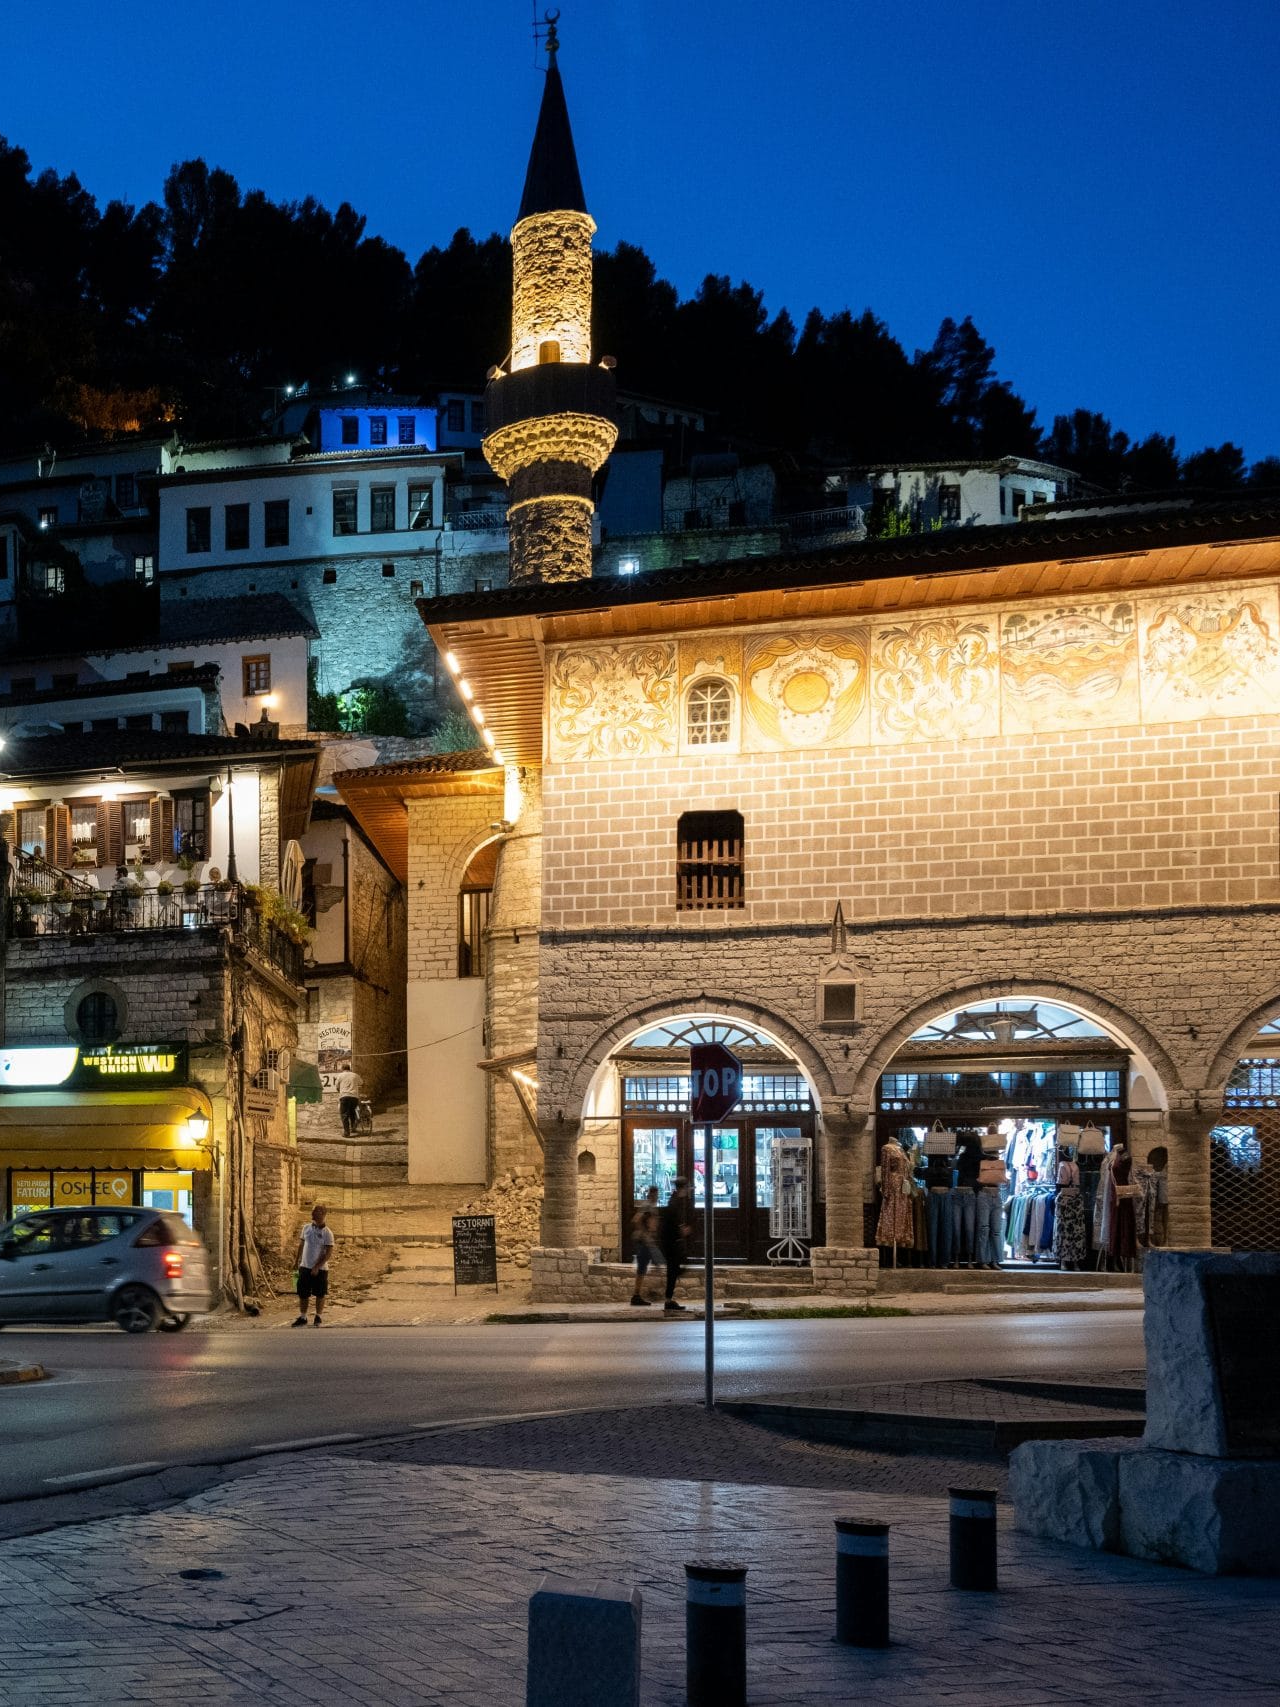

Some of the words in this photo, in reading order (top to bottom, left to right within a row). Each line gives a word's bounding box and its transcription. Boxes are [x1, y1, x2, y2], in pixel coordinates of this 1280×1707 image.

[83, 1055, 137, 1066] WESTERN
[141, 1055, 175, 1073] WU
[100, 1064, 138, 1074] UNION
[691, 1067, 736, 1098] TOP
[61, 1181, 111, 1195] OSHEE
[453, 1217, 494, 1228] RESTORANT
